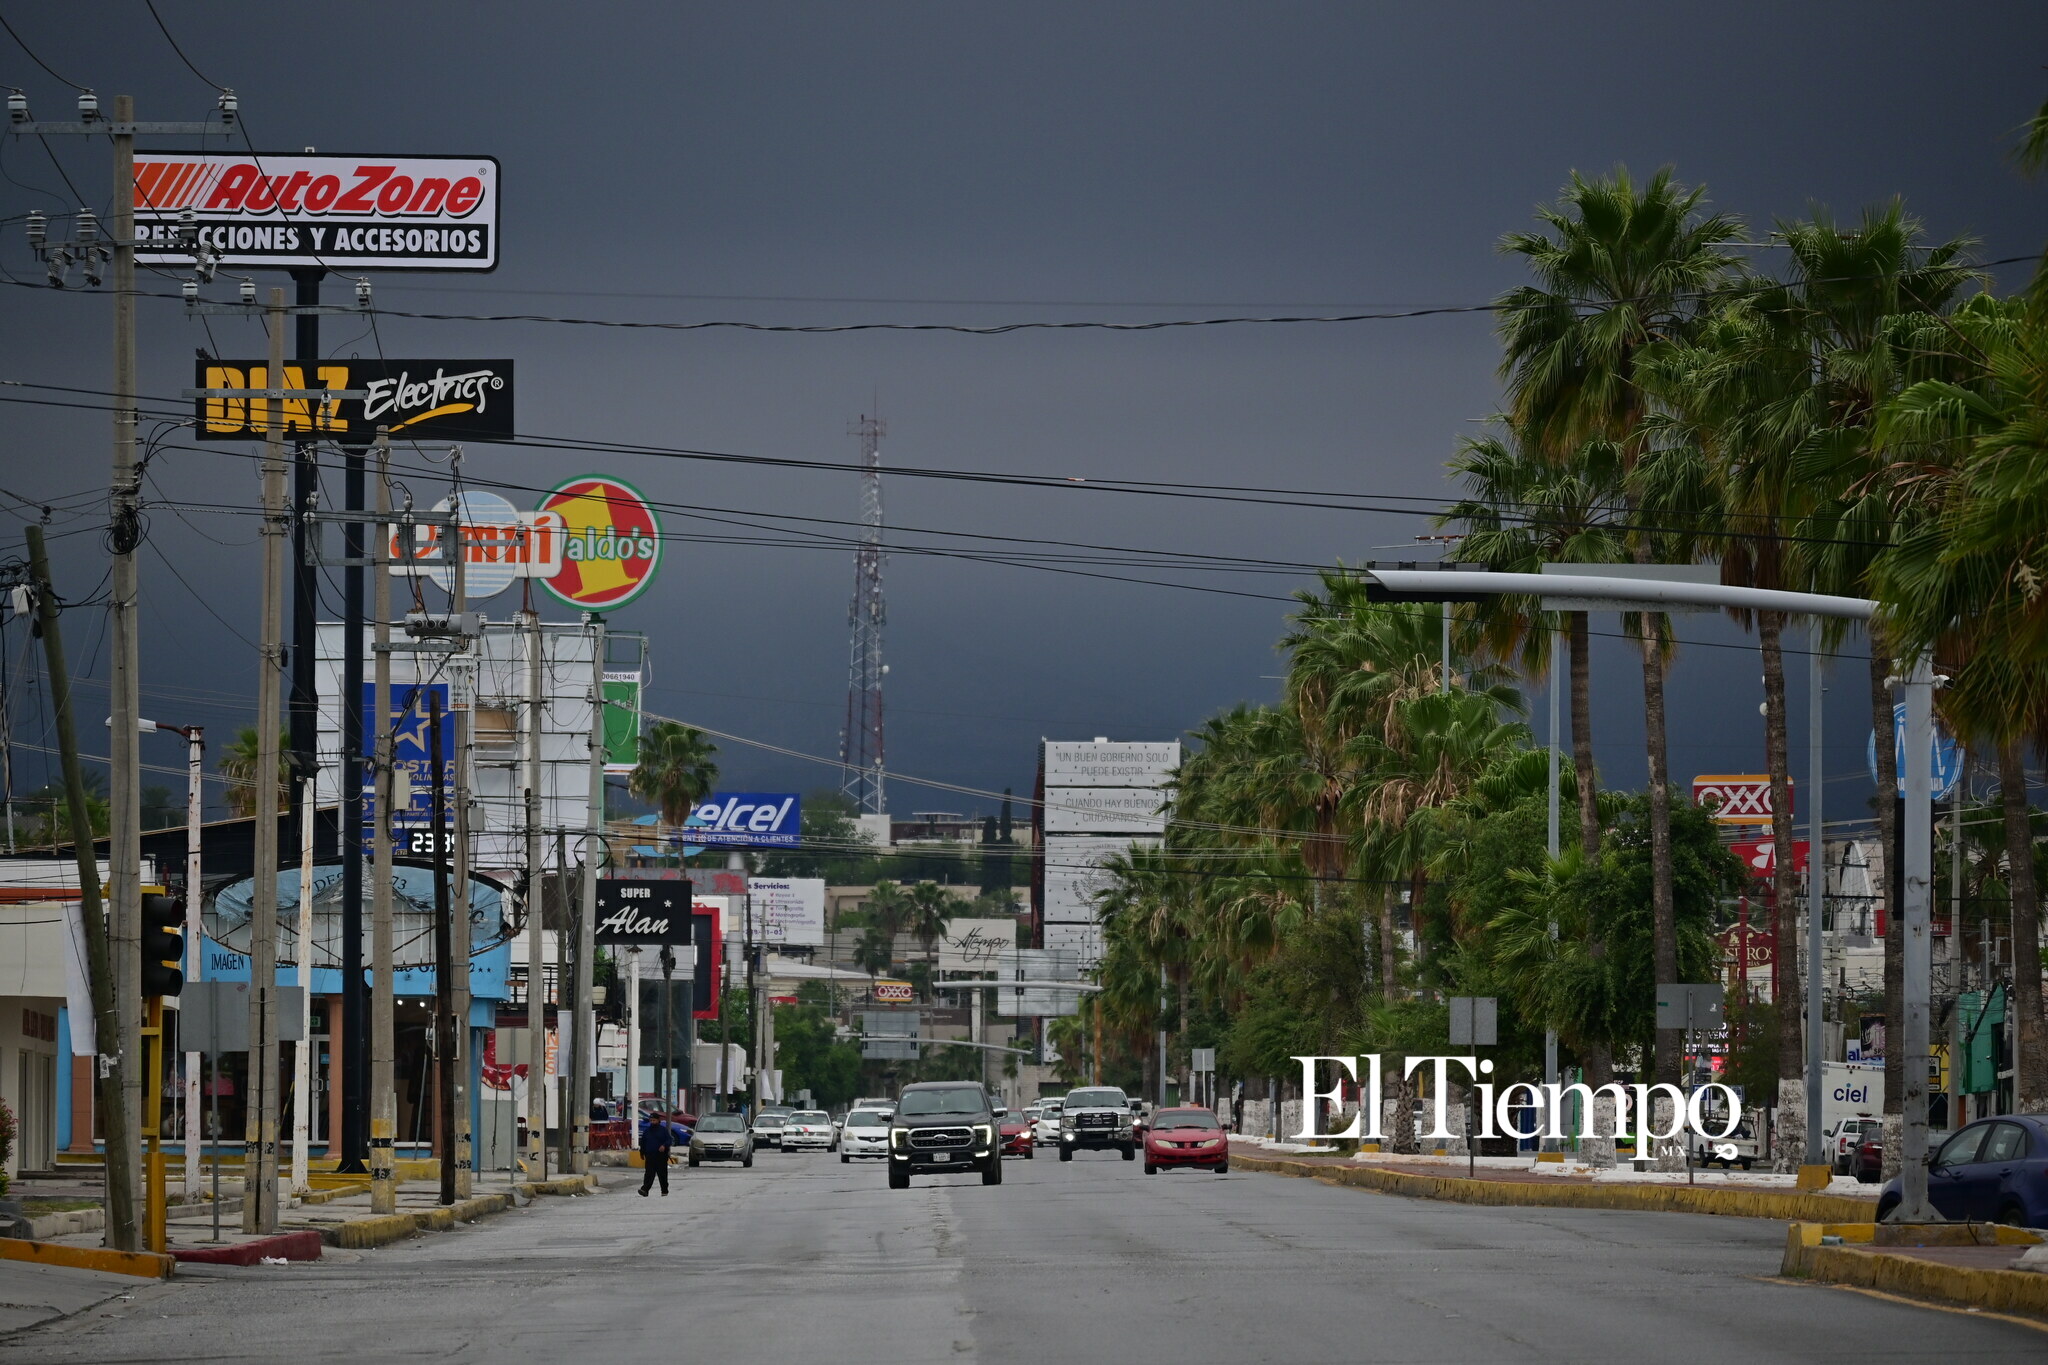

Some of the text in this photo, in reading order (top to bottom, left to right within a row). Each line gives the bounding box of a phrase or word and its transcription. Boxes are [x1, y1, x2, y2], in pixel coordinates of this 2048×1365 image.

[203, 163, 483, 214] AutoZone
[134, 224, 481, 253] REFCCIONES Y ACCESORIOS
[206, 366, 494, 433] DIAZ Electrics
[562, 526, 654, 561] aldo's
[1074, 752, 1098, 762] BUEN
[1101, 753, 1144, 762] GOBIERNO
[1146, 753, 1169, 762] SOLO
[1081, 767, 1144, 776] PUEDE EXISTIR
[1065, 799, 1159, 808] CUANDO HAY BUENOS
[620, 887, 651, 899] SUPER
[753, 882, 790, 890] Servicios:
[595, 905, 670, 935] Alan
[211, 953, 245, 970] IMAGEN
[878, 985, 912, 998] OXXO
[1833, 1083, 1868, 1103] ciel
